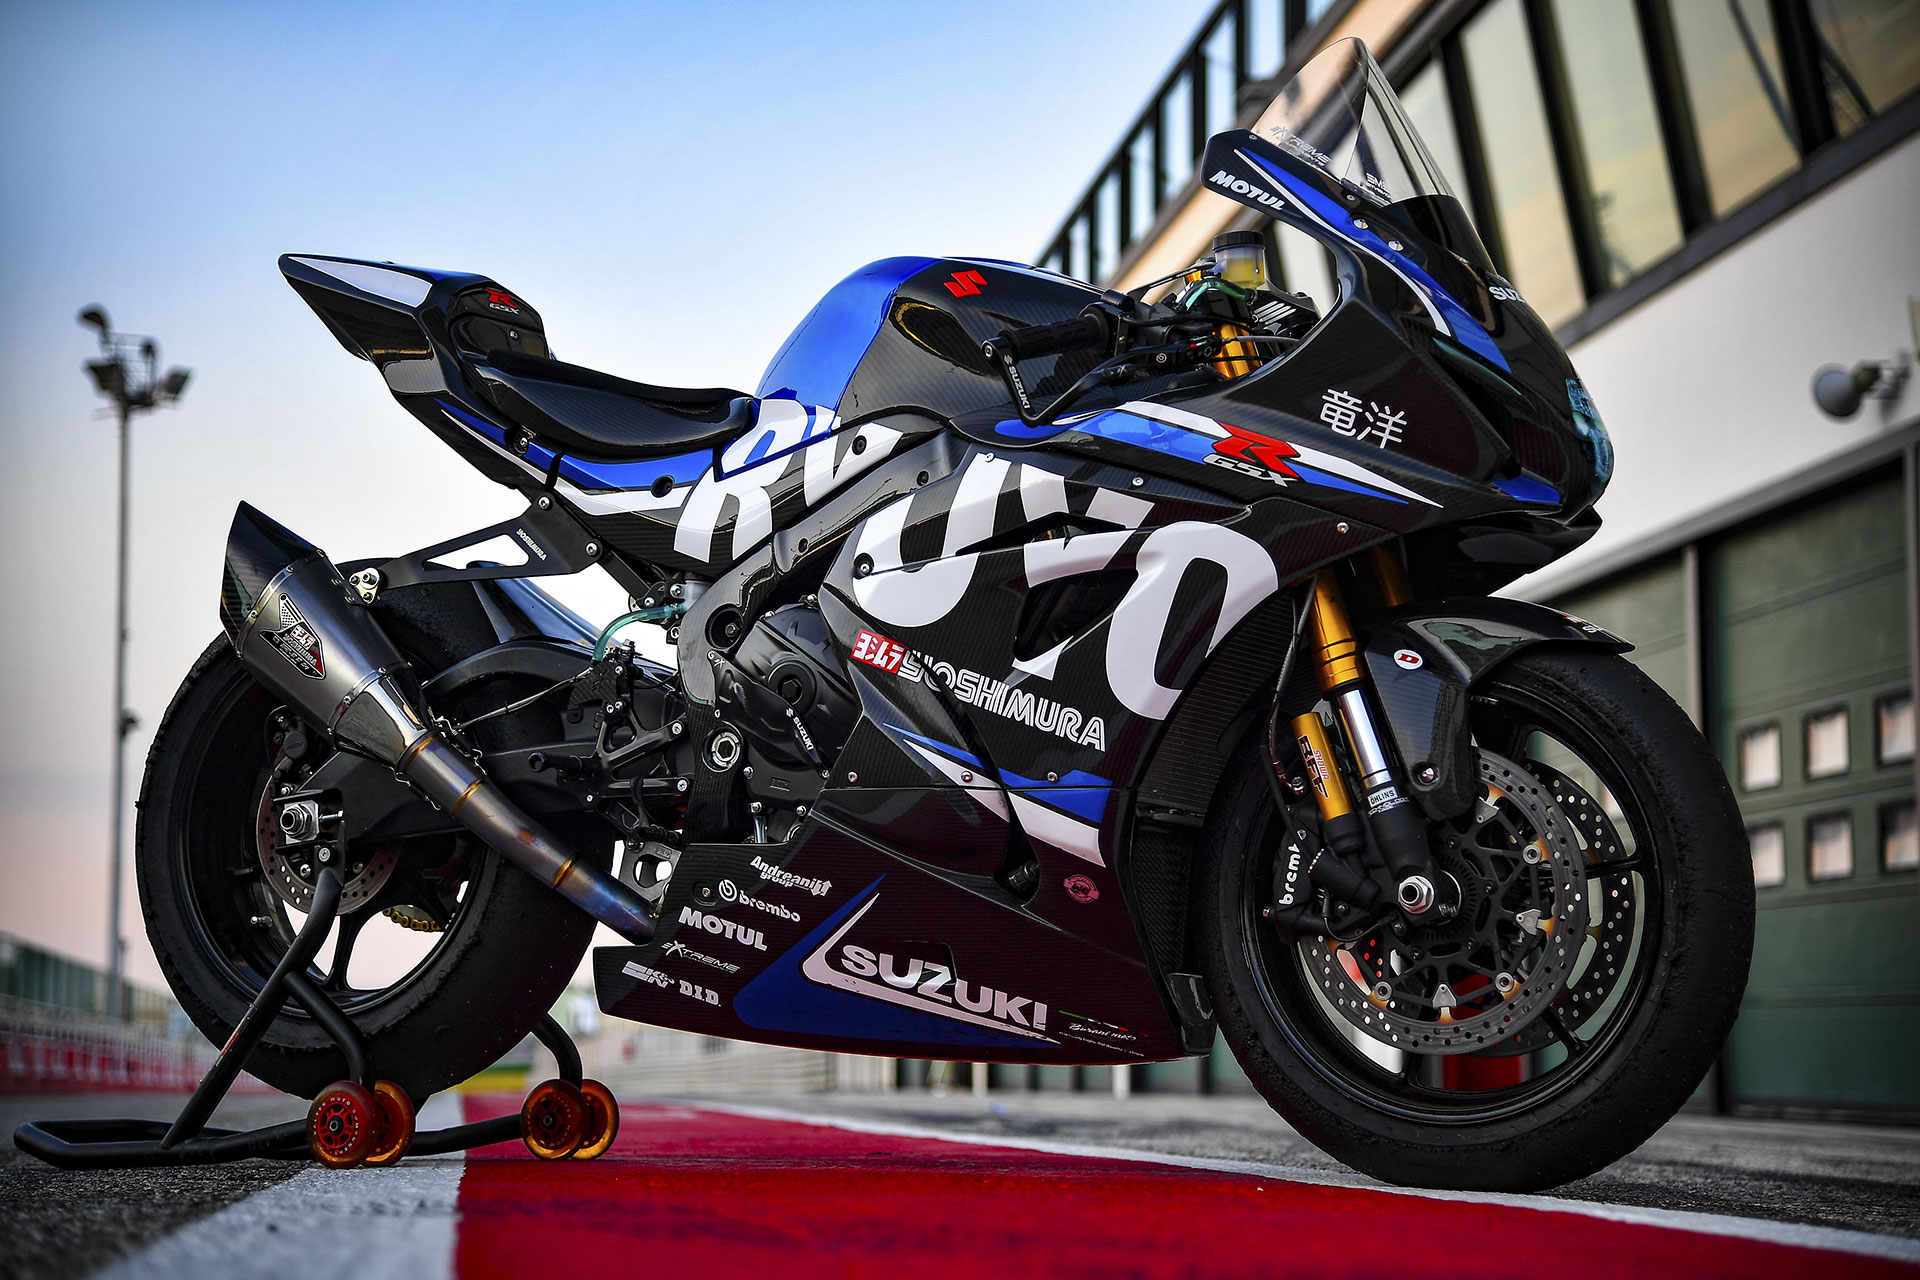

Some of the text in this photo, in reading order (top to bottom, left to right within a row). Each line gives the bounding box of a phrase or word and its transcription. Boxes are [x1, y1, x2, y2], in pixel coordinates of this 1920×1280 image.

[1209, 170, 1286, 211] MOTUL
[1008, 365, 1031, 409] SUZUKI
[1320, 388, 1407, 449] 竜洋
[1203, 453, 1299, 488] GSX
[898, 649, 1106, 753] YOSHIMURA
[793, 716, 815, 751] SUZUKI
[1313, 749, 1330, 780] SHOWA
[750, 855, 817, 889] Andreani
[759, 871, 794, 888] group
[738, 889, 801, 923] brembo
[678, 905, 768, 951] MOTUL
[841, 944, 1048, 1031] SUZUKI
